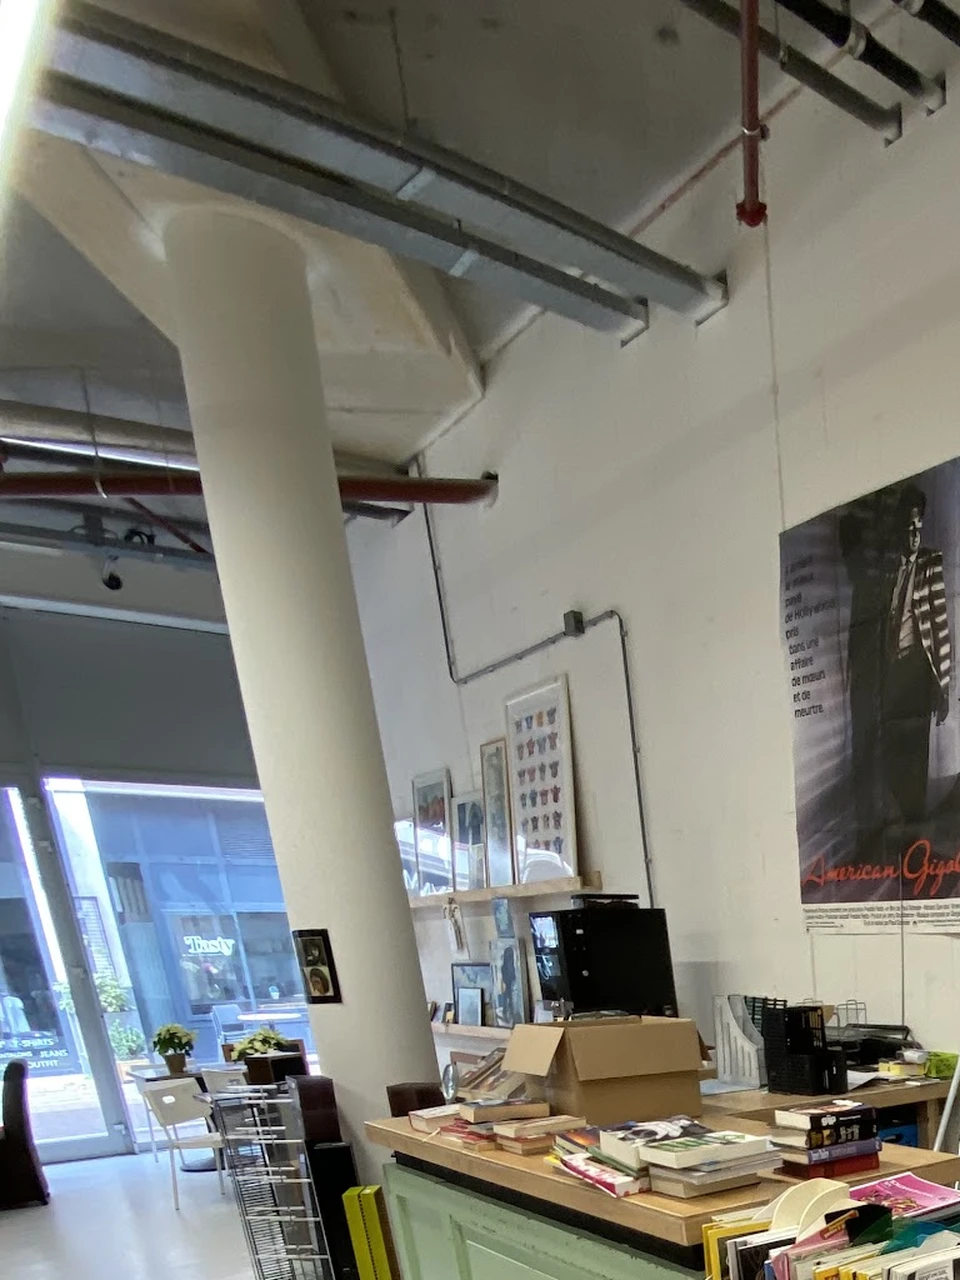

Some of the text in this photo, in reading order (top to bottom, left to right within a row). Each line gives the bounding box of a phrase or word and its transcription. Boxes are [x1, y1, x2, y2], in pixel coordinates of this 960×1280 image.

[786, 627, 799, 639] pris
[791, 657, 813, 671] affaire
[792, 676, 801, 686] de
[793, 690, 810, 702] et de
[801, 854, 899, 886] American
[183, 935, 236, 956] Tasty
[40, 1049, 69, 1058] JEANS
